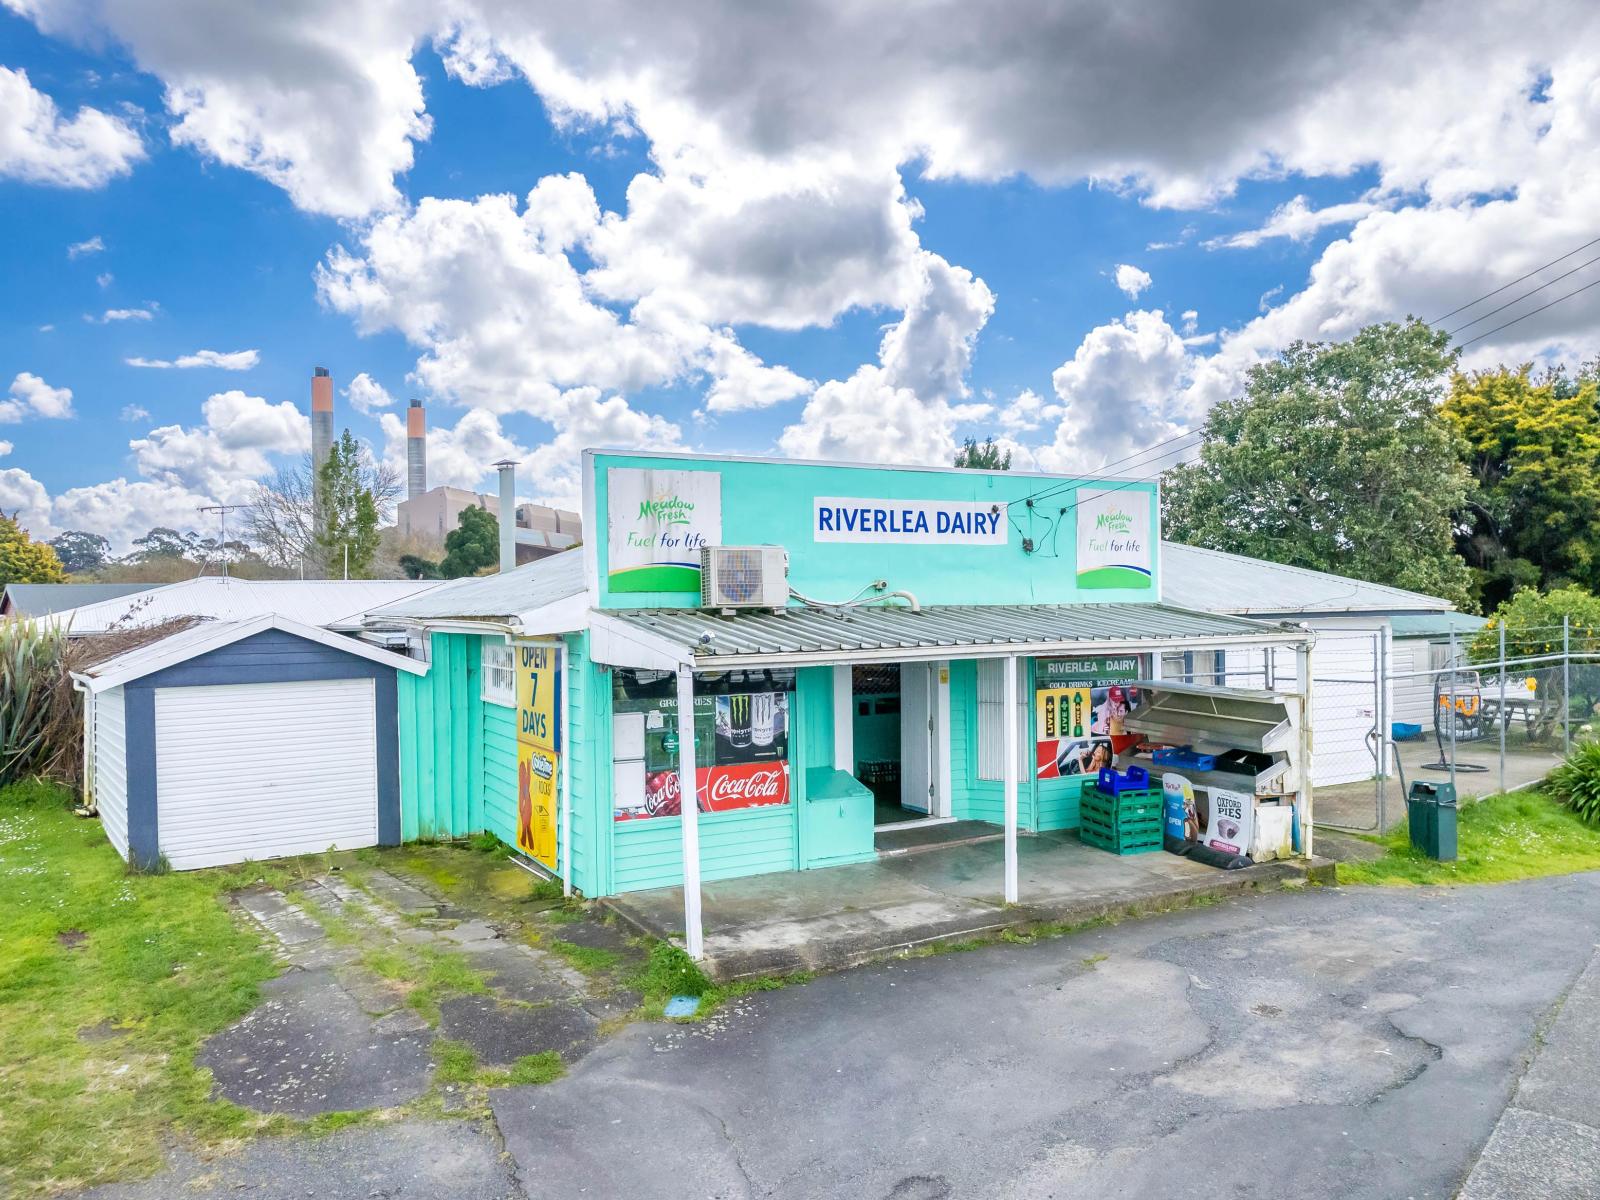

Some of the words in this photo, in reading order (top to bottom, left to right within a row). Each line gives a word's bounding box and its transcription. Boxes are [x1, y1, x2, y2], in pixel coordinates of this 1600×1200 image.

[637, 496, 694, 520] Meadow
[657, 510, 686, 527] Fresh
[819, 507, 929, 533] RIVERLEA
[936, 511, 1000, 535] DAIRY
[1096, 510, 1133, 530] Meadow
[1108, 521, 1127, 533] Fresh
[626, 531, 656, 548] Fuel
[660, 532, 681, 548] for
[684, 533, 706, 548] life
[1088, 539, 1108, 552] Fuel
[1110, 539, 1122, 552] for
[1125, 540, 1140, 552] life
[522, 646, 547, 669] OPEN
[1047, 661, 1098, 674] RIVERLEA
[1105, 659, 1136, 671] DAIRY
[530, 672, 538, 707] 7
[1068, 680, 1093, 688] DRINKS
[659, 698, 712, 708] GRORIES
[522, 708, 547, 739] DAYS
[711, 769, 783, 801] Coca-Cola
[1216, 796, 1242, 809] OXFORD
[1218, 807, 1242, 820] PIES
